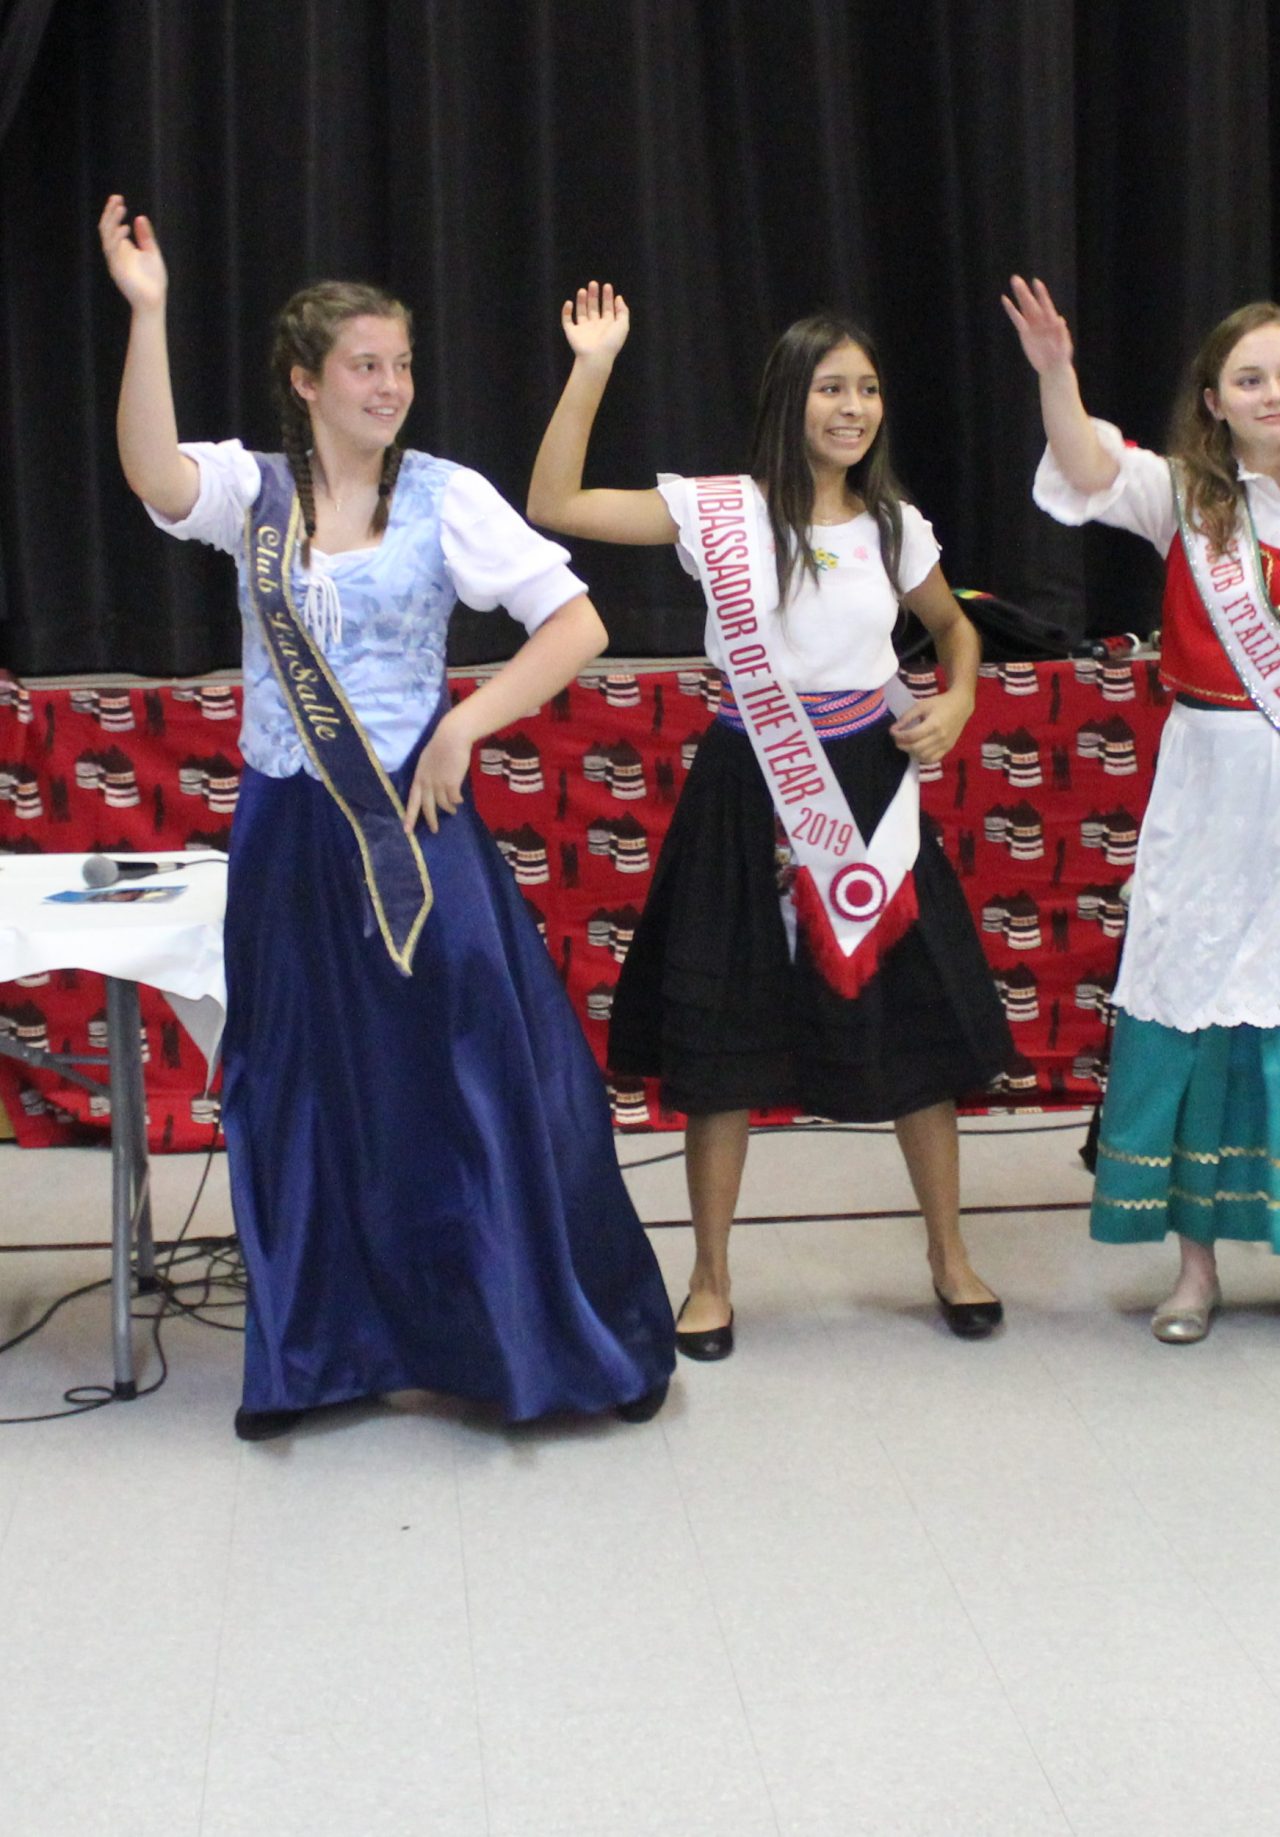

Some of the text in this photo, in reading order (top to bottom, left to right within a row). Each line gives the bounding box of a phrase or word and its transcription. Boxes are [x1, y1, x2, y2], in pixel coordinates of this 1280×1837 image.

[256, 525, 281, 594] Club
[695, 475, 854, 857] MBASSADOR OF THE YEAR 2019
